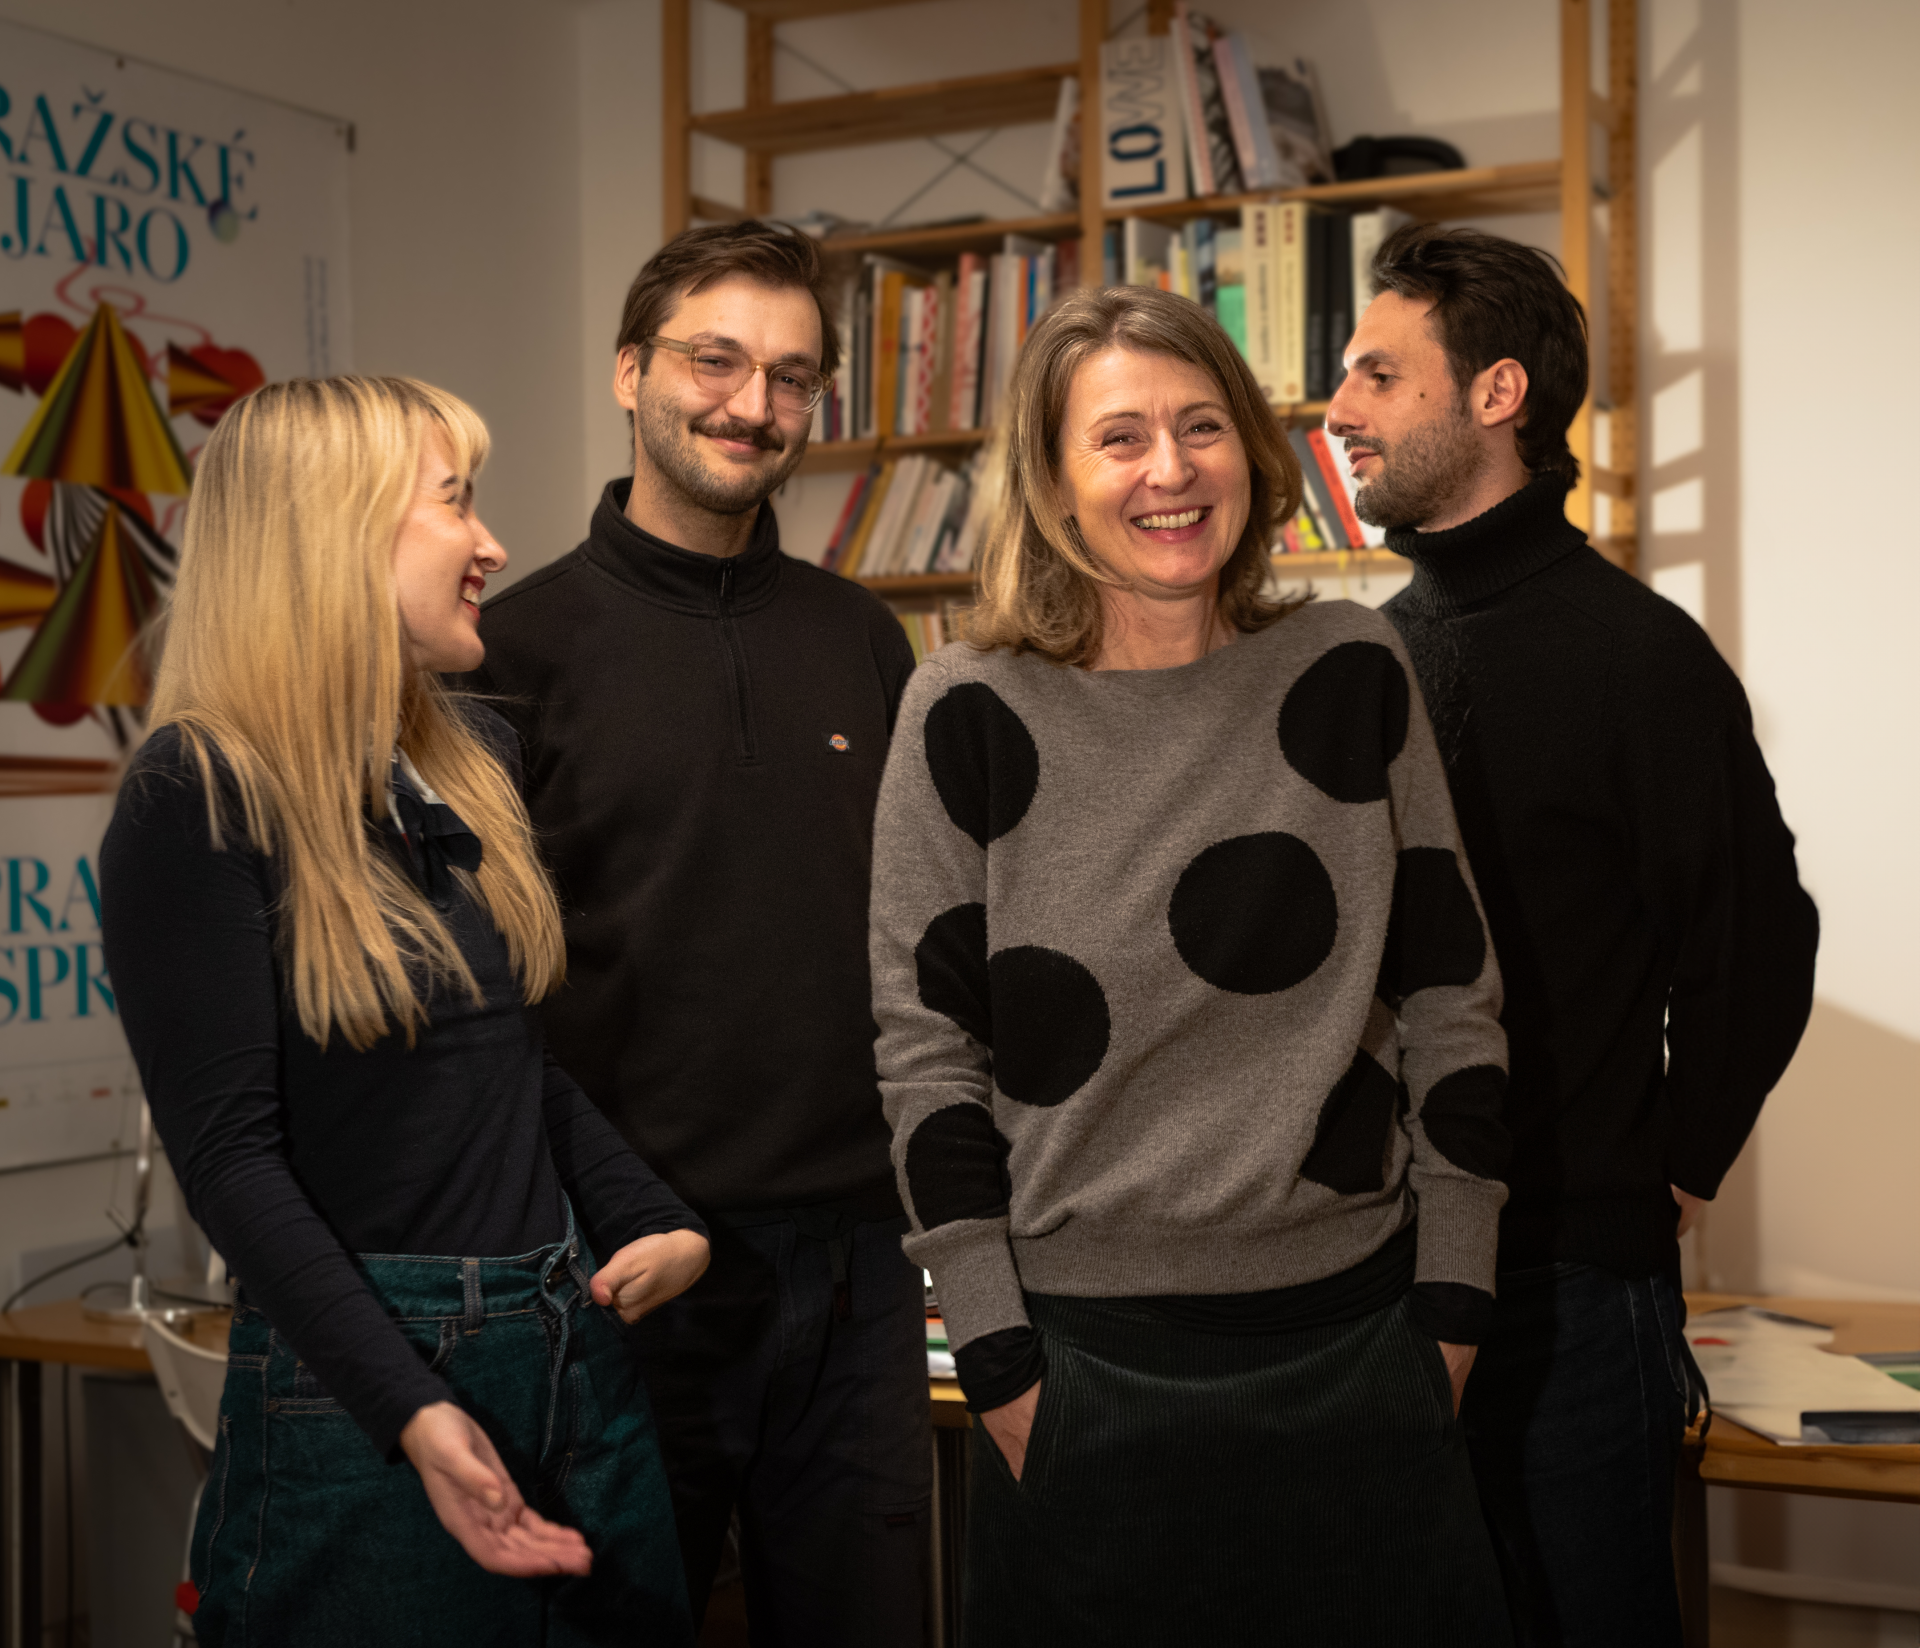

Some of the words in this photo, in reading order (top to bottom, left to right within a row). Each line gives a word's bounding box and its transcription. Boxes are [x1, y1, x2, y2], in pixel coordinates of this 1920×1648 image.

[0, 84, 258, 222] AŽSKÉ
[1, 173, 191, 285] JARO
[0, 854, 102, 936] RA
